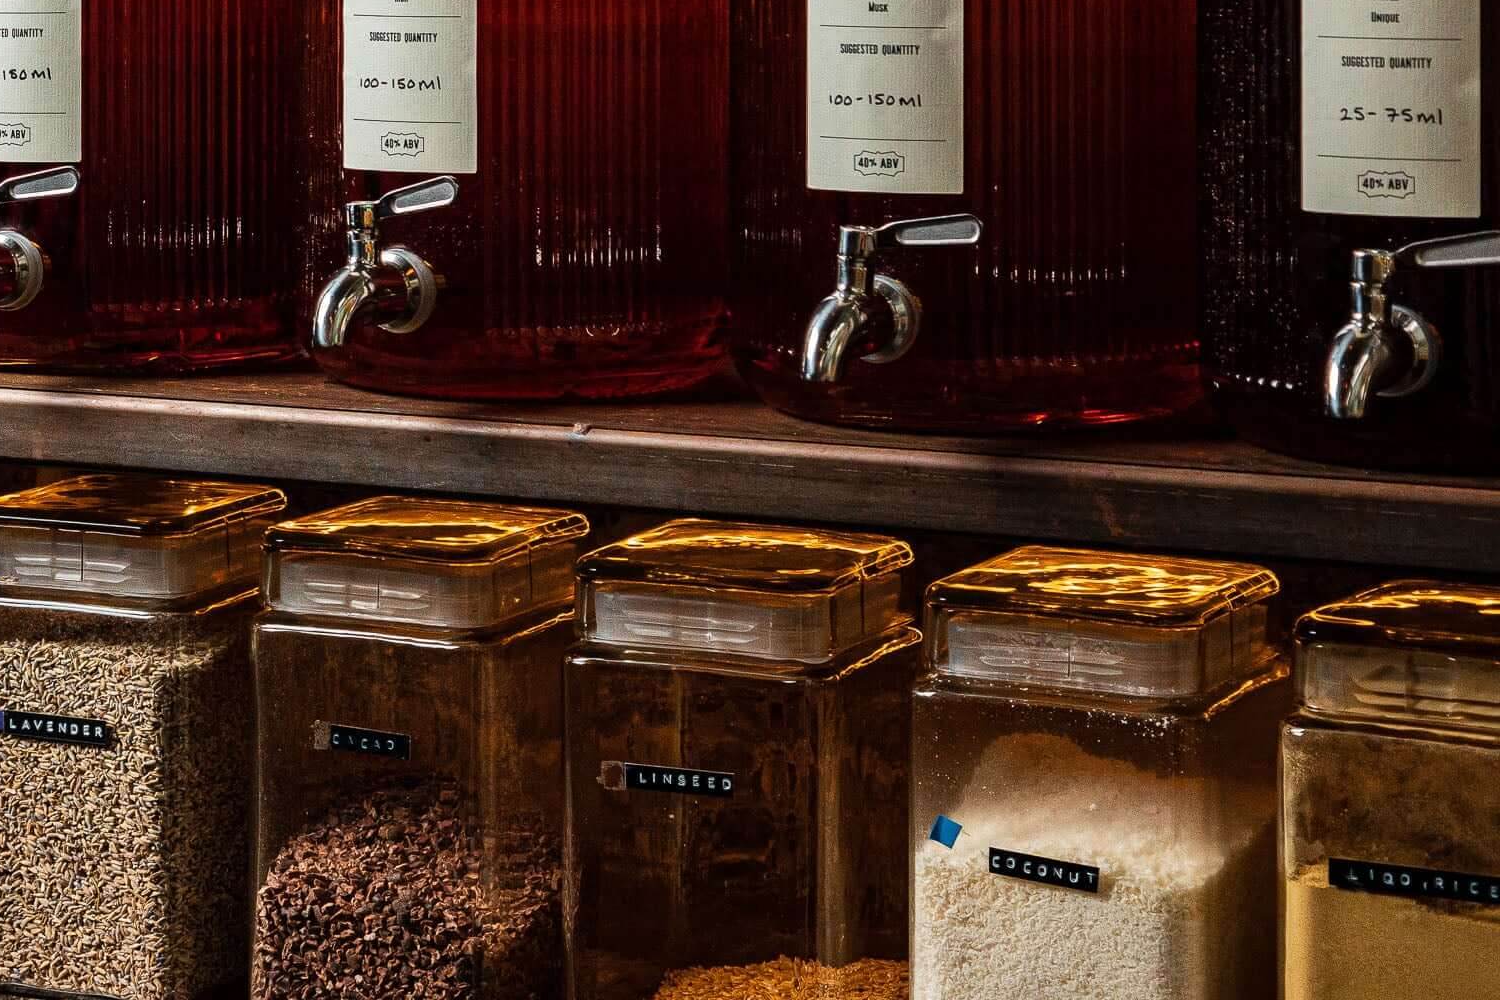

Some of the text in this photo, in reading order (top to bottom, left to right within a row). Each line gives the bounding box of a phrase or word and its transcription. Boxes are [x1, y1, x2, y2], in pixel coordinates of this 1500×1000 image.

[11, 28, 44, 38] QUANTITY
[369, 31, 438, 43] SUGGESTED QUANTITY
[840, 43, 920, 56] SUGGESTED QUANTITY
[1341, 55, 1432, 69] SUGGESTED QUANTITY
[10, 129, 26, 139] ABV
[384, 139, 419, 149] 40% ABV
[858, 158, 899, 169] 40% ABV
[1362, 178, 1408, 190] 40% ABV
[9, 718, 103, 738] LAVENDER
[639, 772, 732, 790] LINSEED
[991, 855, 1096, 884] COCONUT
